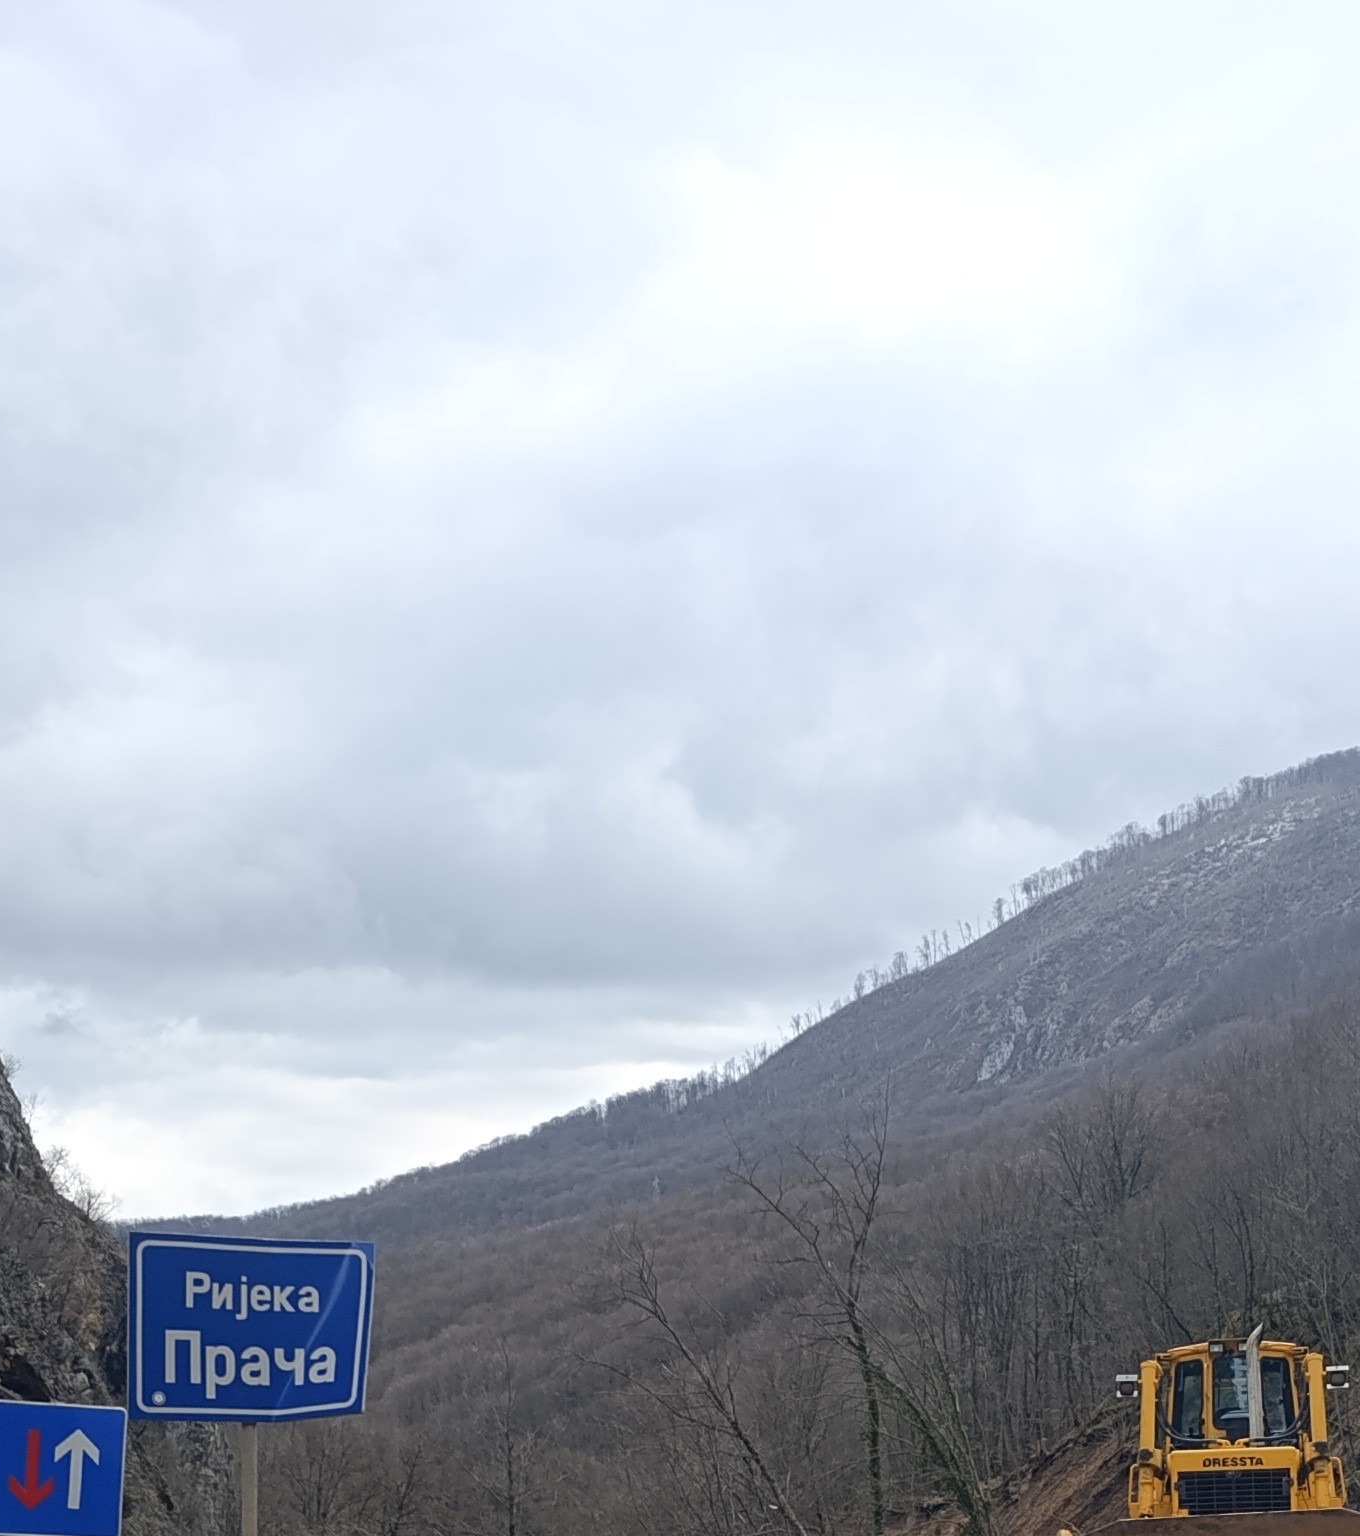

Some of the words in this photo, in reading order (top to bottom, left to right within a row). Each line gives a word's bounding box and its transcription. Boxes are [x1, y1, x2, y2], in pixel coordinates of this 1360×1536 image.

[185, 1271, 320, 1320] Ријека
[164, 1329, 337, 1399] Прача
[1202, 1456, 1264, 1468] DRESSTA
